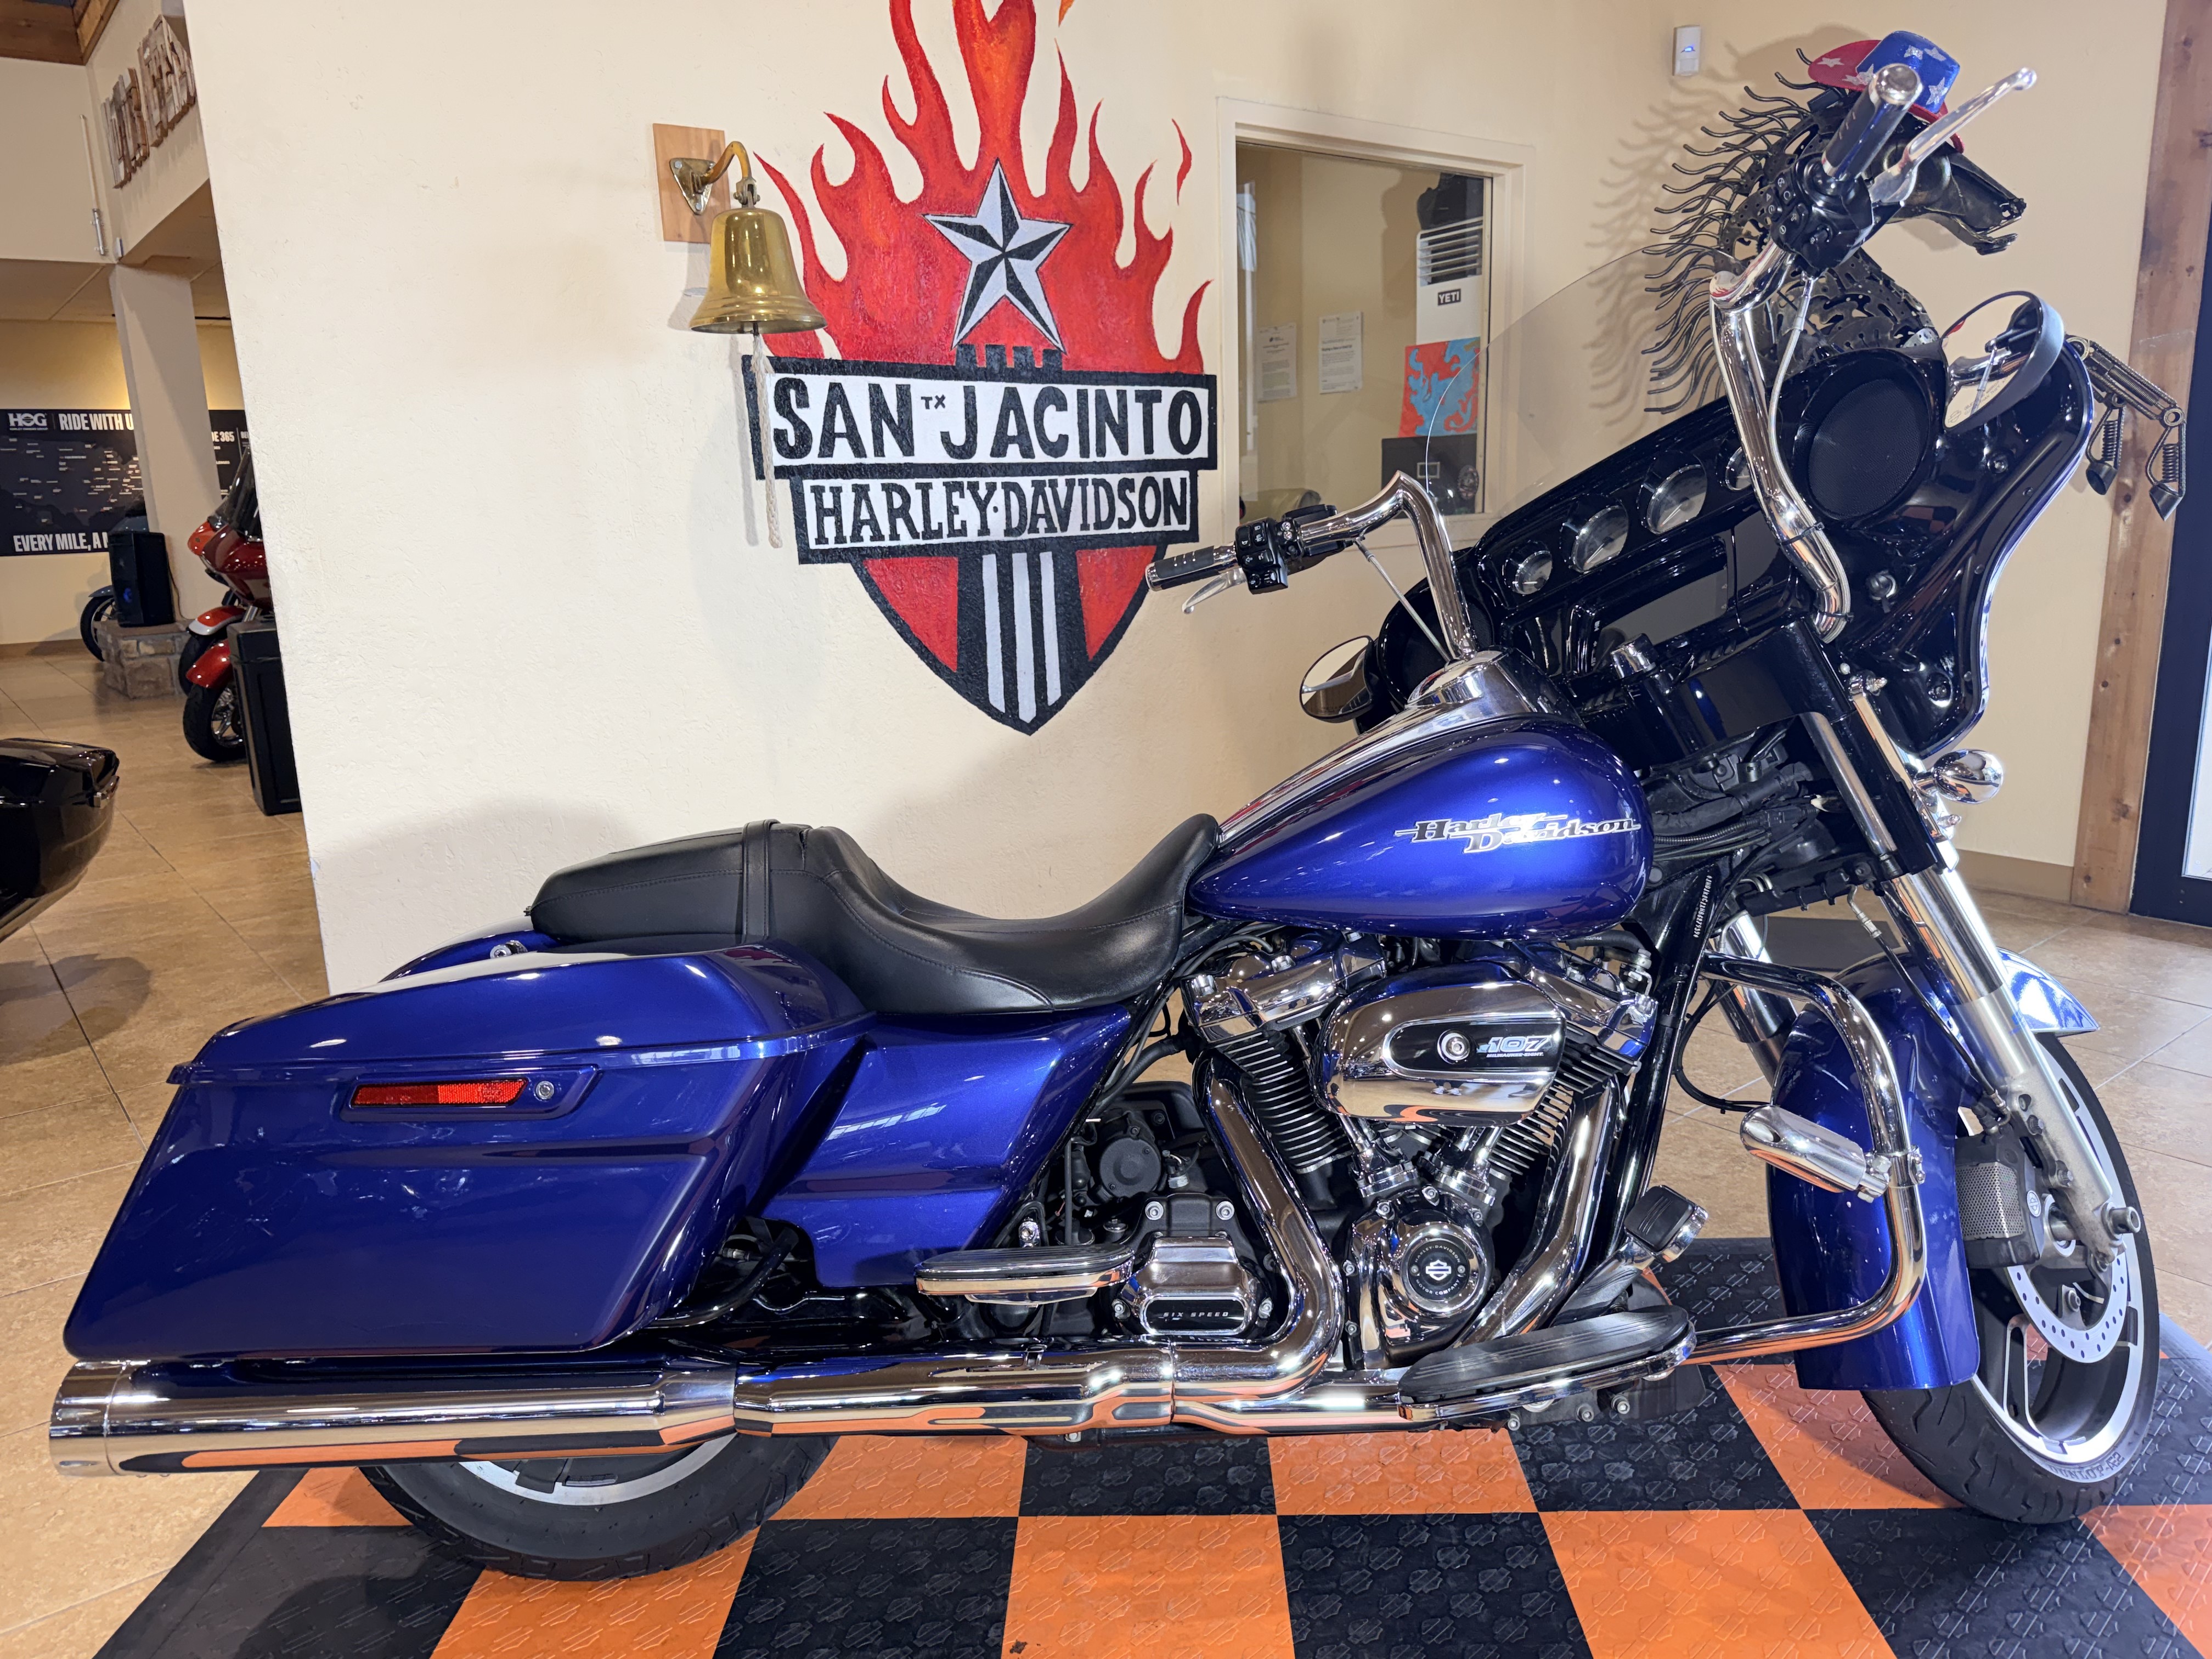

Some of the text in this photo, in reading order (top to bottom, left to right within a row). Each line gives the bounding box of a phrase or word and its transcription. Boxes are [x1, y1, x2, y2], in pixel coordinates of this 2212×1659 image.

[1438, 291, 1459, 303] YETI
[8, 413, 134, 430] HOG RIDE WITH U
[774, 377, 1202, 459] SAN TX JACINTO
[219, 431, 235, 442] 365
[13, 534, 53, 552] EVERY
[55, 533, 91, 551] MILE,
[92, 532, 102, 549] A
[1487, 1035, 1551, 1053] 107
[1416, 1279, 1460, 1295] MOTOR COMPANY
